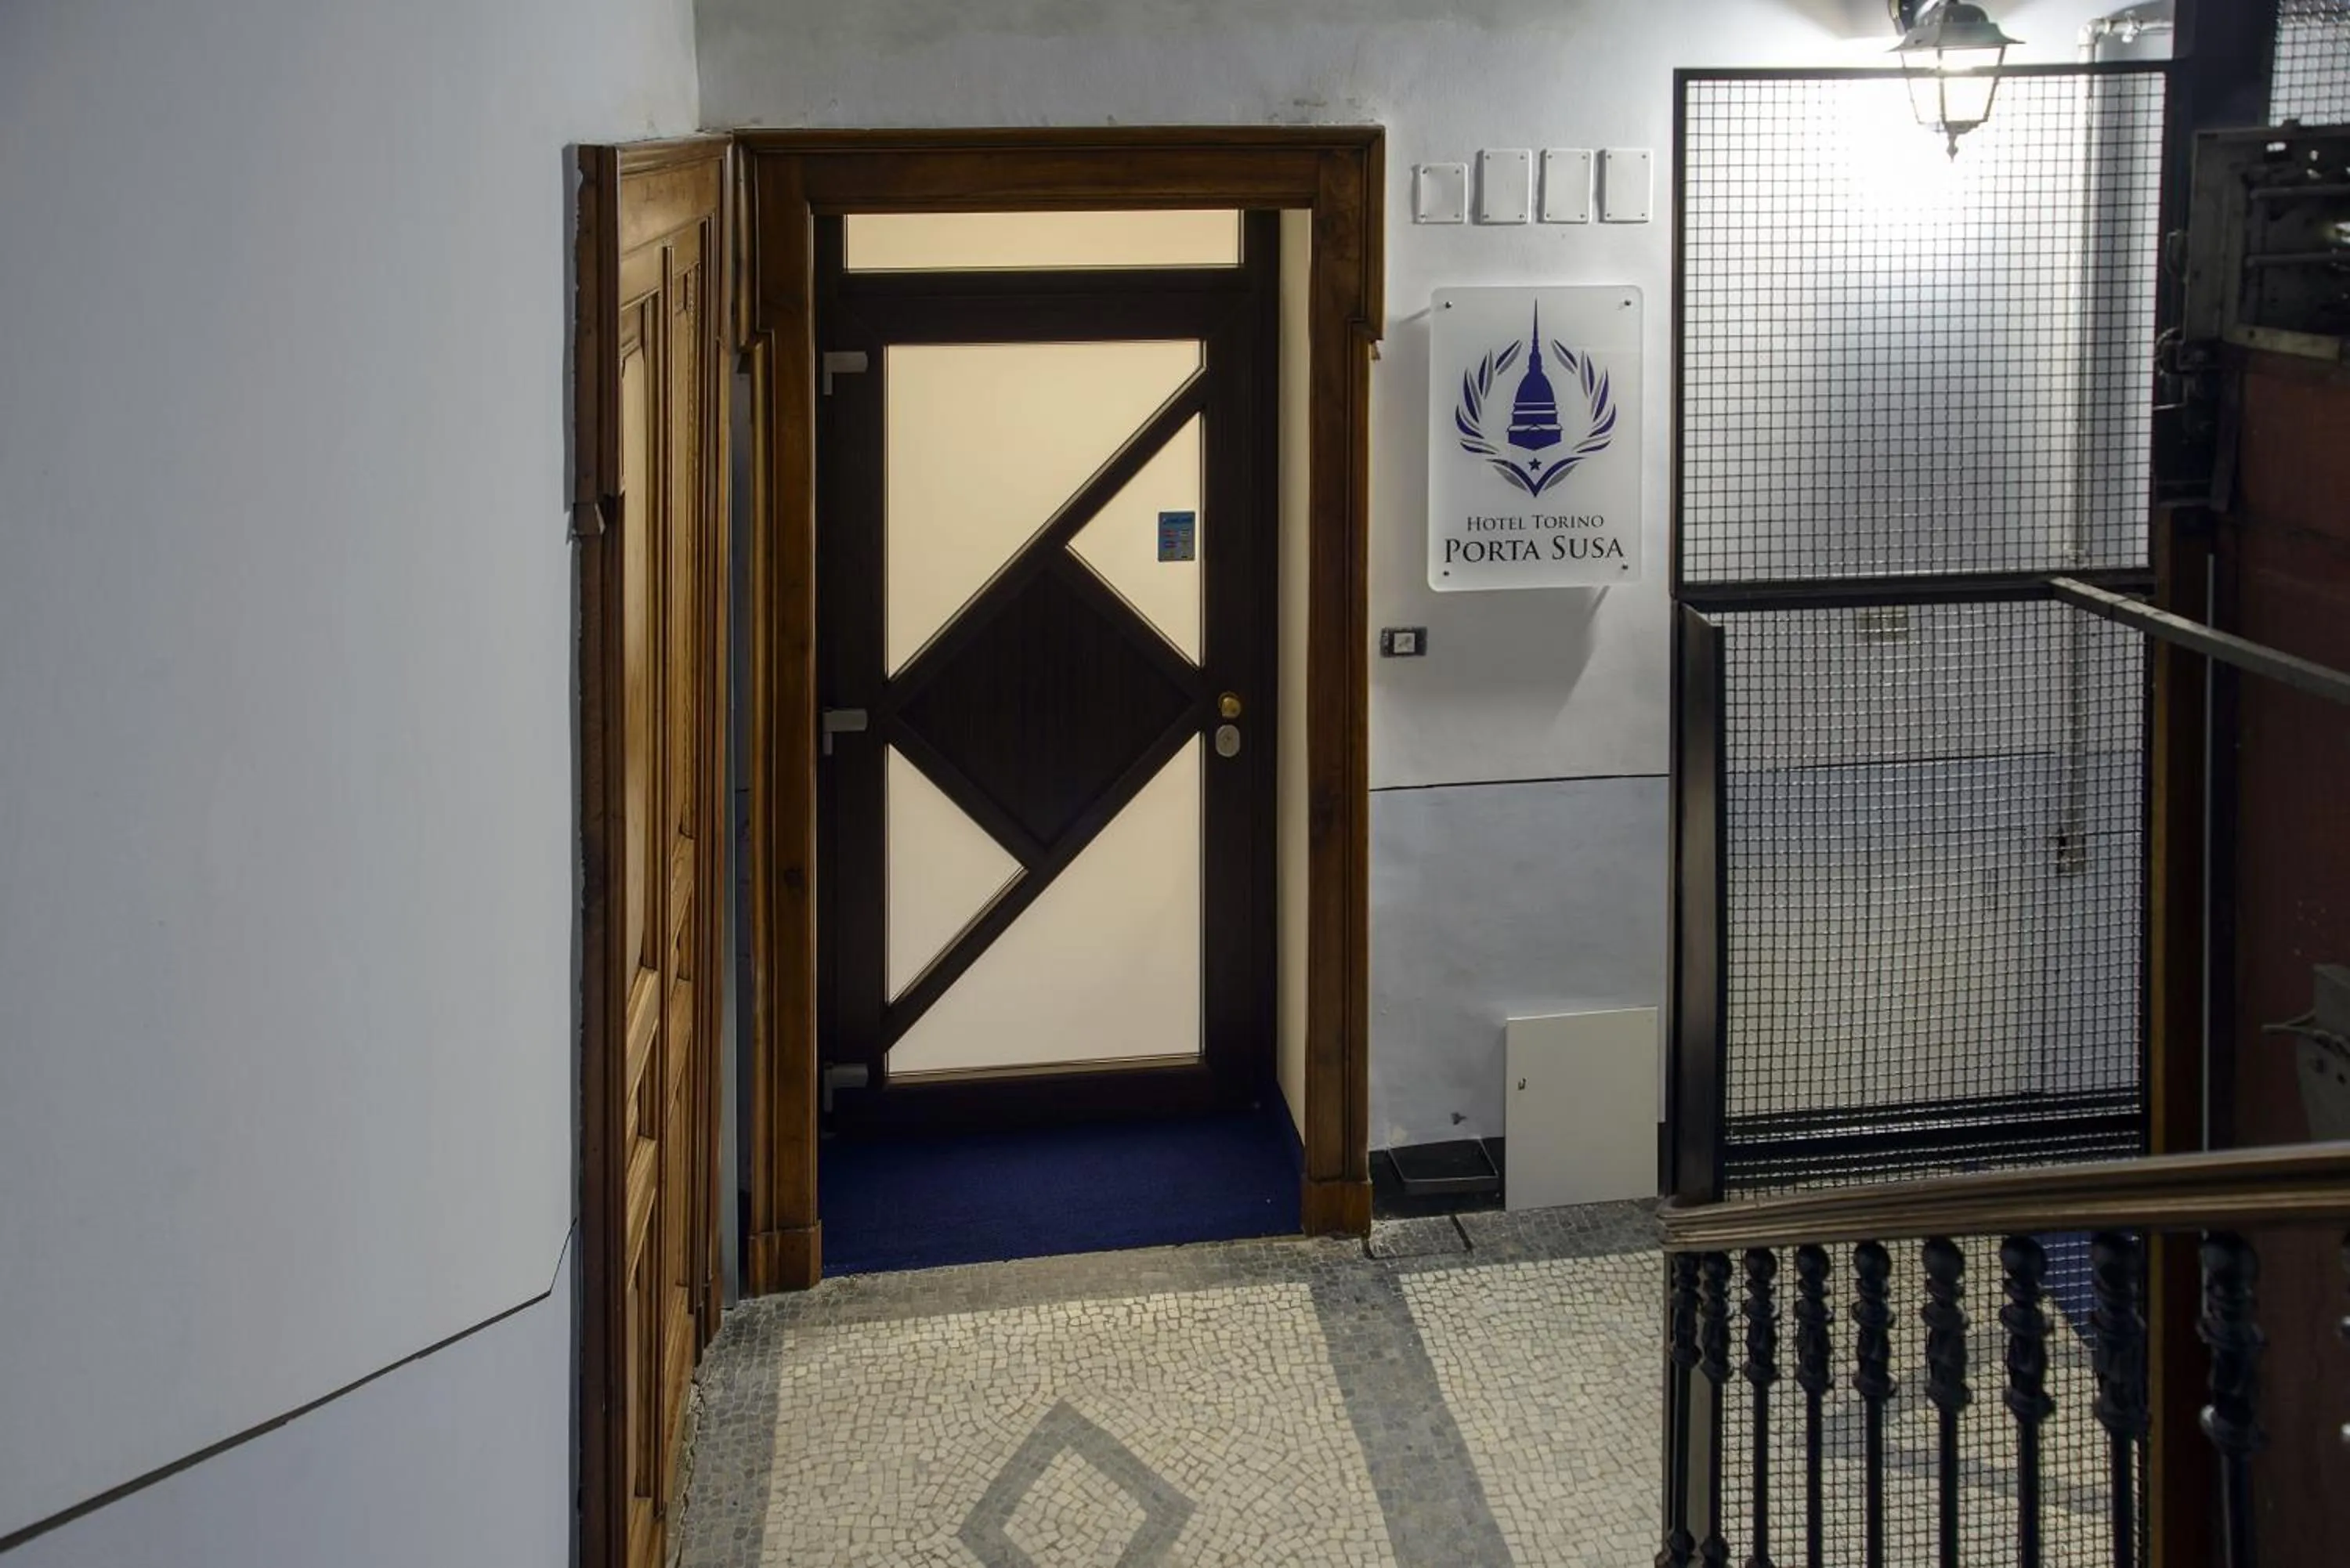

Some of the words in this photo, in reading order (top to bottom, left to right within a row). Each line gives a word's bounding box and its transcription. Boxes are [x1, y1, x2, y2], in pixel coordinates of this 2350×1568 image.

[1467, 516, 1527, 531] HOTEL
[1531, 515, 1604, 529] TORINO
[1444, 538, 1542, 563] PORTA
[1552, 535, 1624, 560] SUSA
